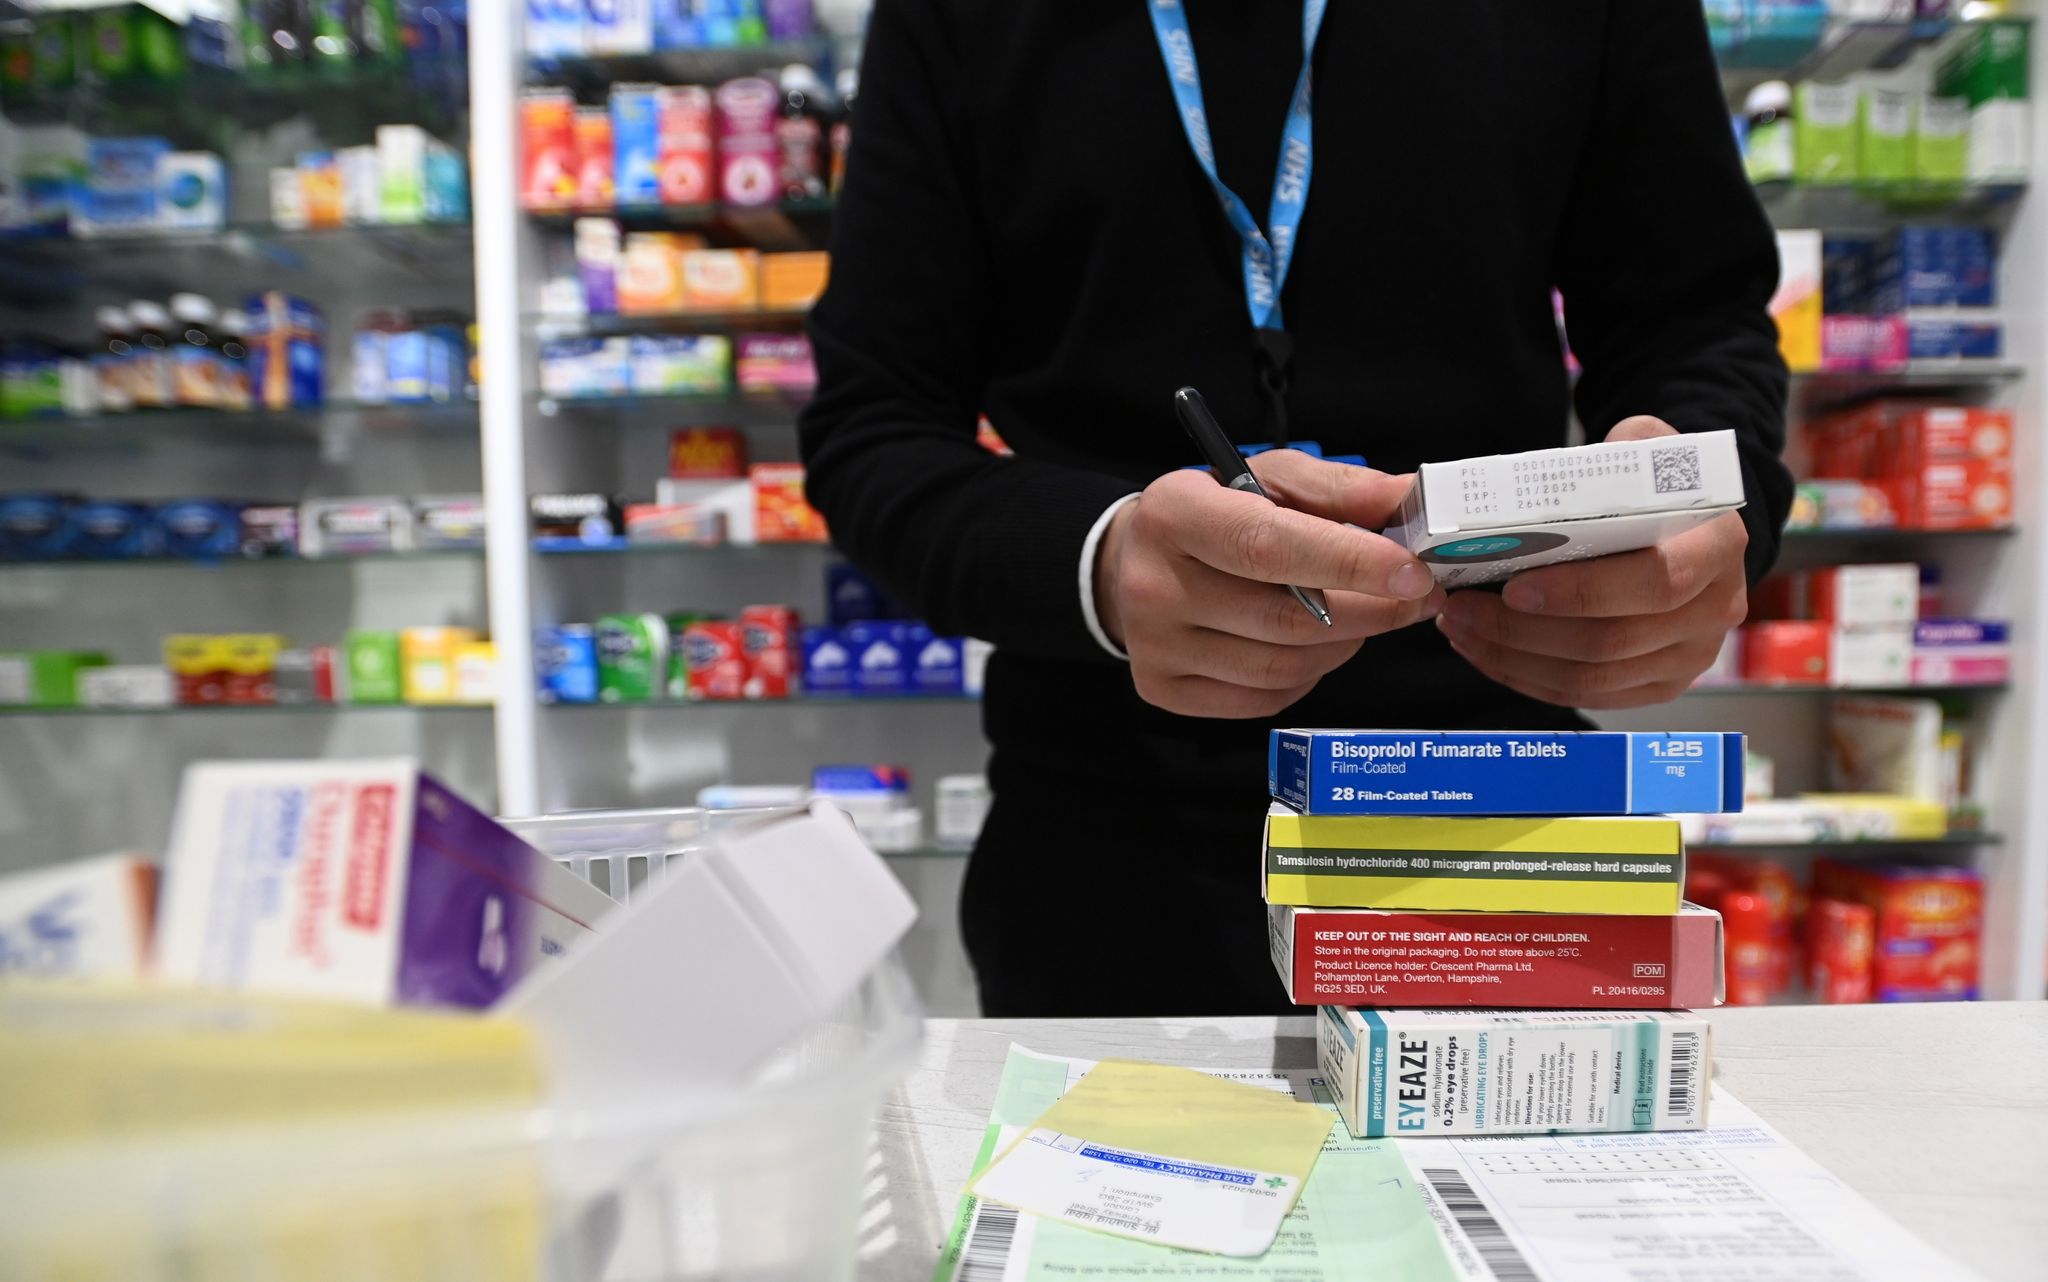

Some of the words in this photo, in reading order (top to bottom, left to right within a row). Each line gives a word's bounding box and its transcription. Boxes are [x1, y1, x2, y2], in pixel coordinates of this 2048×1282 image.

[1163, 28, 1197, 86] NHS
[1462, 468, 1485, 477] PC:
[1514, 450, 1638, 472] 05017007603993
[1463, 480, 1486, 489] SN:
[1464, 491, 1496, 502] EXP:
[1516, 481, 1576, 497] 01/2025
[1465, 504, 1498, 514] Lot:
[1518, 497, 1560, 509] 26416
[1332, 741, 1415, 759] Bisoprolol
[1422, 741, 1502, 757] Fumarate
[1507, 741, 1566, 757] Tablets
[1648, 741, 1703, 757] 1.25
[1332, 761, 1406, 774] Film-Coated
[1666, 765, 1685, 777] mg
[1332, 787, 1354, 801] 28
[1358, 791, 1428, 800] Film-Coated
[1431, 791, 1473, 800] Tablets
[1276, 855, 1334, 866] Tamsulosin
[1337, 856, 1408, 869] hydrochloride
[1410, 858, 1430, 868] 400
[1433, 859, 1490, 871] microgram
[1493, 860, 1592, 873] prolonged-release
[1594, 861, 1620, 872] hard
[1622, 862, 1672, 875] capsules
[1315, 931, 1344, 941] KEEP
[1346, 931, 1369, 941] OUT
[1371, 932, 1387, 941] OF
[1389, 932, 1411, 941] THE
[1413, 932, 1446, 941] SIGHT
[1448, 933, 1472, 941] AND
[1474, 933, 1512, 942] REACH
[1515, 933, 1530, 942] OF
[1532, 933, 1590, 942] CHILDREN.
[1315, 946, 1341, 955] Store
[1343, 946, 1352, 955] in
[1354, 947, 1370, 955] the
[1372, 947, 1407, 958] original
[1409, 948, 1461, 958] packaging.
[1464, 947, 1479, 957] Do
[1481, 948, 1496, 957] not
[1499, 948, 1523, 957] store
[1525, 948, 1555, 957] above
[1315, 960, 1352, 970] Product
[1355, 961, 1392, 970] Licence
[1395, 961, 1427, 971] holder:
[1430, 961, 1473, 971] Crescent
[1476, 962, 1513, 971] Pharma
[1515, 962, 1534, 972] Ltd,
[1637, 966, 1661, 975] POM
[1315, 972, 1372, 983] Polhampton
[1375, 973, 1401, 983] Lane,
[1403, 973, 1445, 983] Overton,
[1314, 984, 1342, 993] RG25
[1344, 984, 1367, 994] 3ED,
[1370, 985, 1388, 994] UK.
[1593, 986, 1606, 995] PL
[1608, 986, 1665, 995] 20416/0295
[1445, 1036, 1459, 1071] drops
[1478, 1032, 1488, 1059] DROPS
[1689, 1036, 1699, 1072] 962283
[1374, 1047, 1386, 1065] free
[1458, 1047, 1471, 1066] free)
[1432, 1046, 1444, 1089] hyaluronate
[1478, 1062, 1487, 1075] EYE
[1447, 1073, 1457, 1094] eye
[1458, 1067, 1469, 1114] (preservative
[1373, 1066, 1385, 1120] preservative
[1431, 1091, 1441, 1117] sodium
[1443, 1097, 1454, 1126] 0.2%
[1475, 1077, 1486, 1129] LUBRICATING
[1524, 1096, 1533, 1125] Directions
[1083, 1149, 1101, 1157] 1589
[1103, 1153, 1122, 1162] 7222
[1123, 1157, 1139, 1165] 020
[1157, 1163, 1221, 1181] PHARMACY
[1223, 1174, 1253, 1185] STAR
